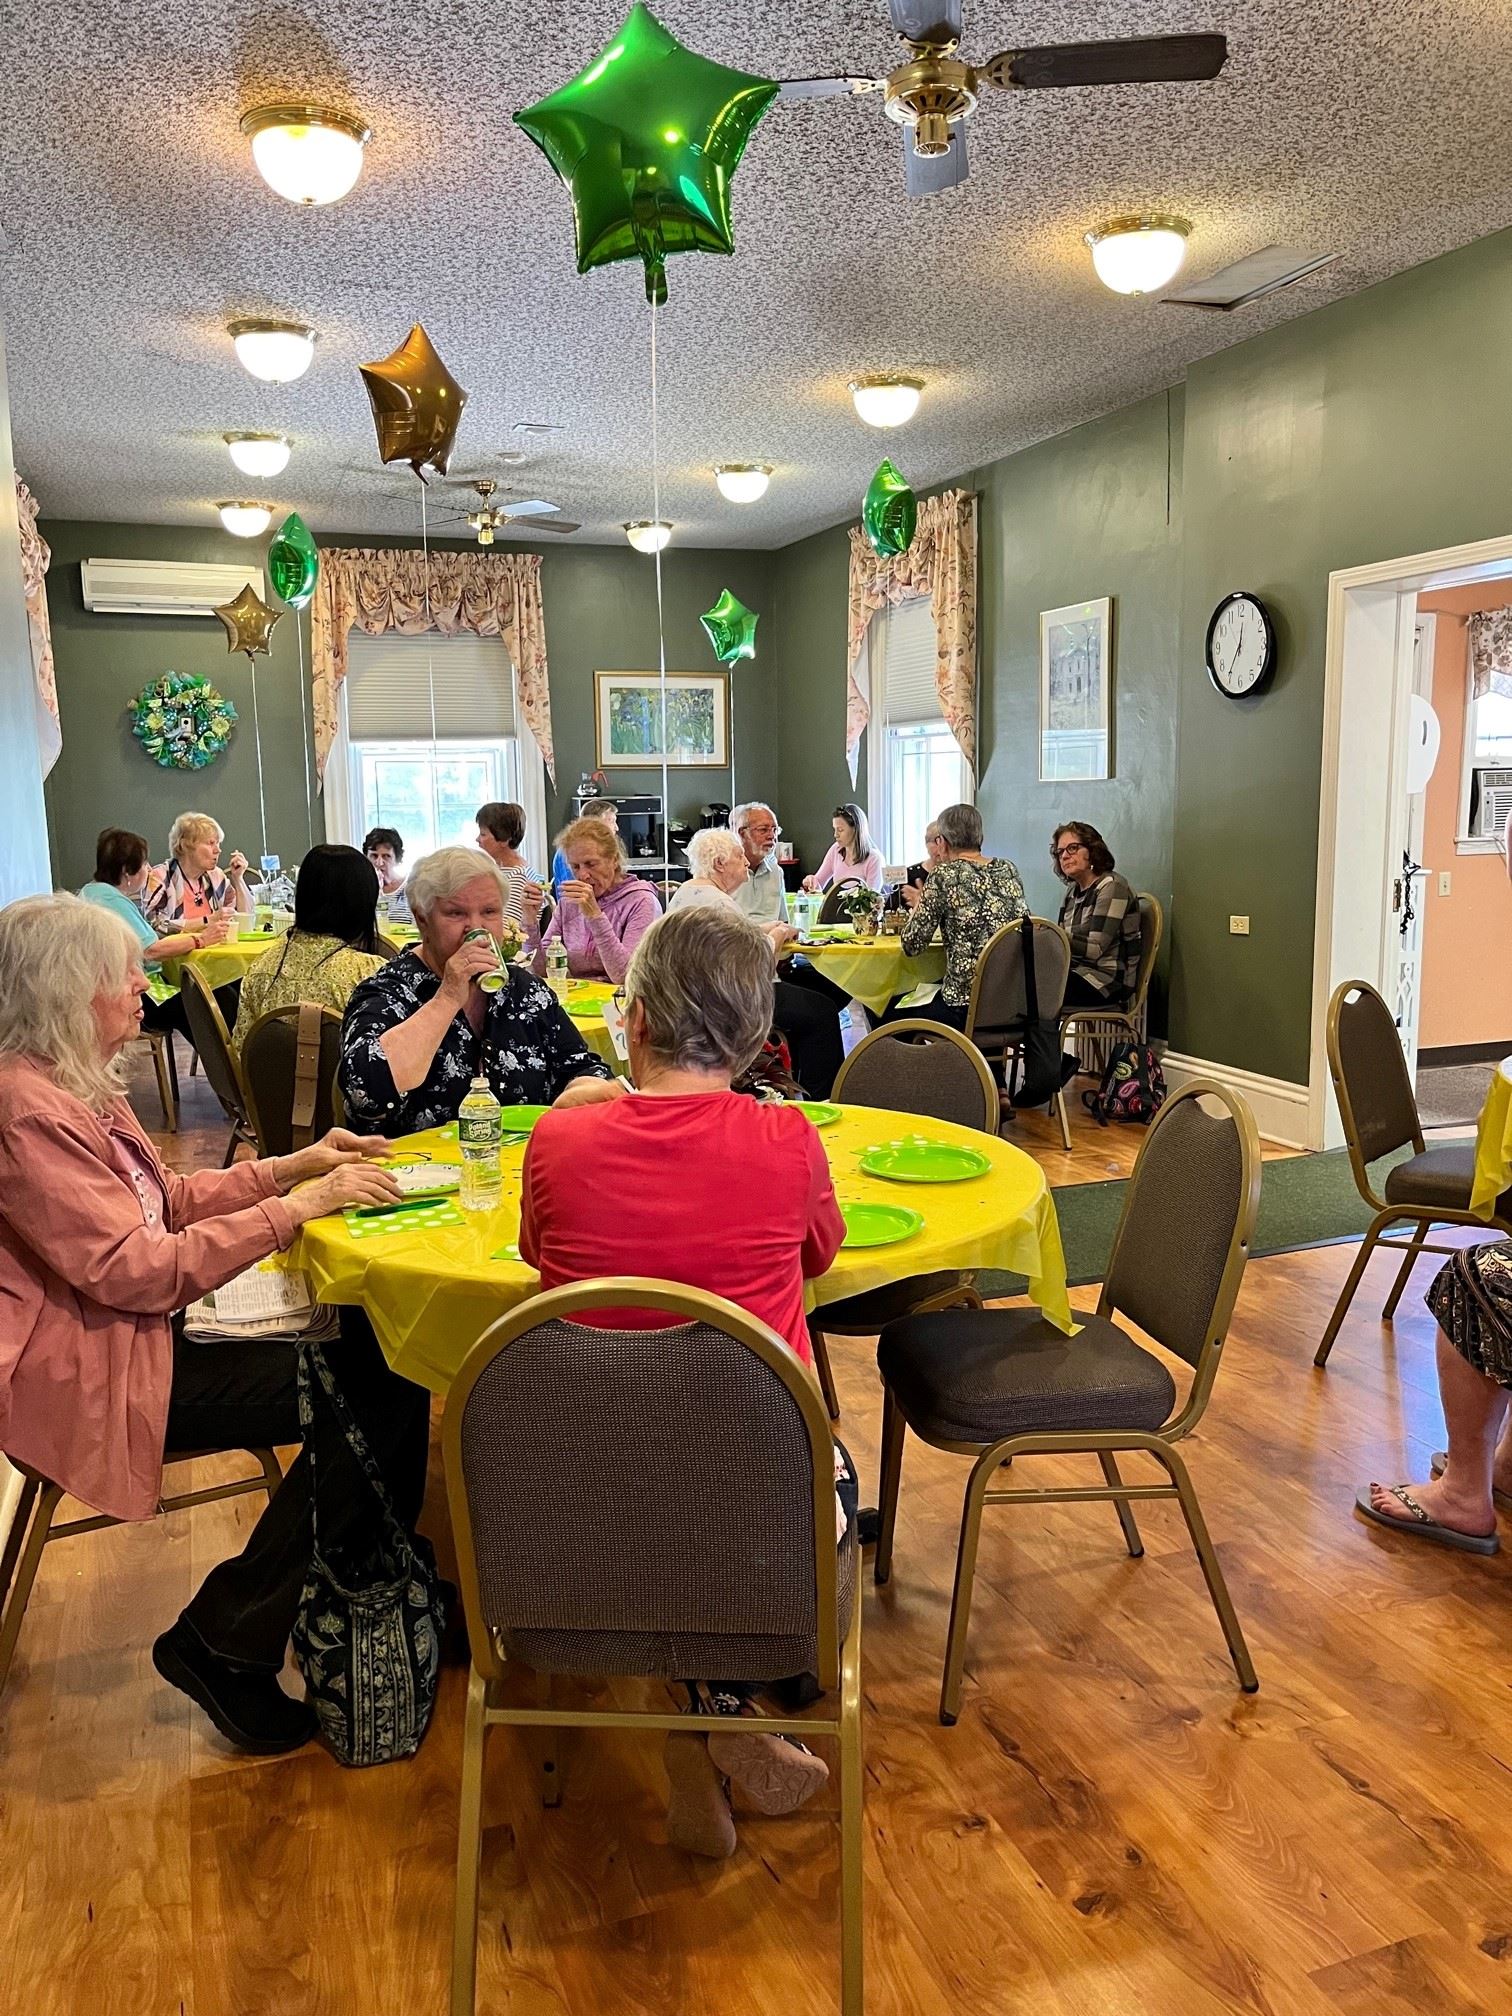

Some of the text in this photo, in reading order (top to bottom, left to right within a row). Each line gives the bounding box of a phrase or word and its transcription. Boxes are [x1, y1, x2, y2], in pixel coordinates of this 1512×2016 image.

[1238, 604, 1245, 617] 12
[1228, 611, 1234, 624] 11
[1219, 624, 1227, 637] 10
[1257, 619, 1263, 632] 2
[1215, 642, 1220, 655] 9
[1261, 637, 1266, 650] 3
[1219, 659, 1225, 672] 8
[1257, 656, 1262, 666] 4
[1238, 675, 1243, 688] 6
[1249, 670, 1254, 682] 5
